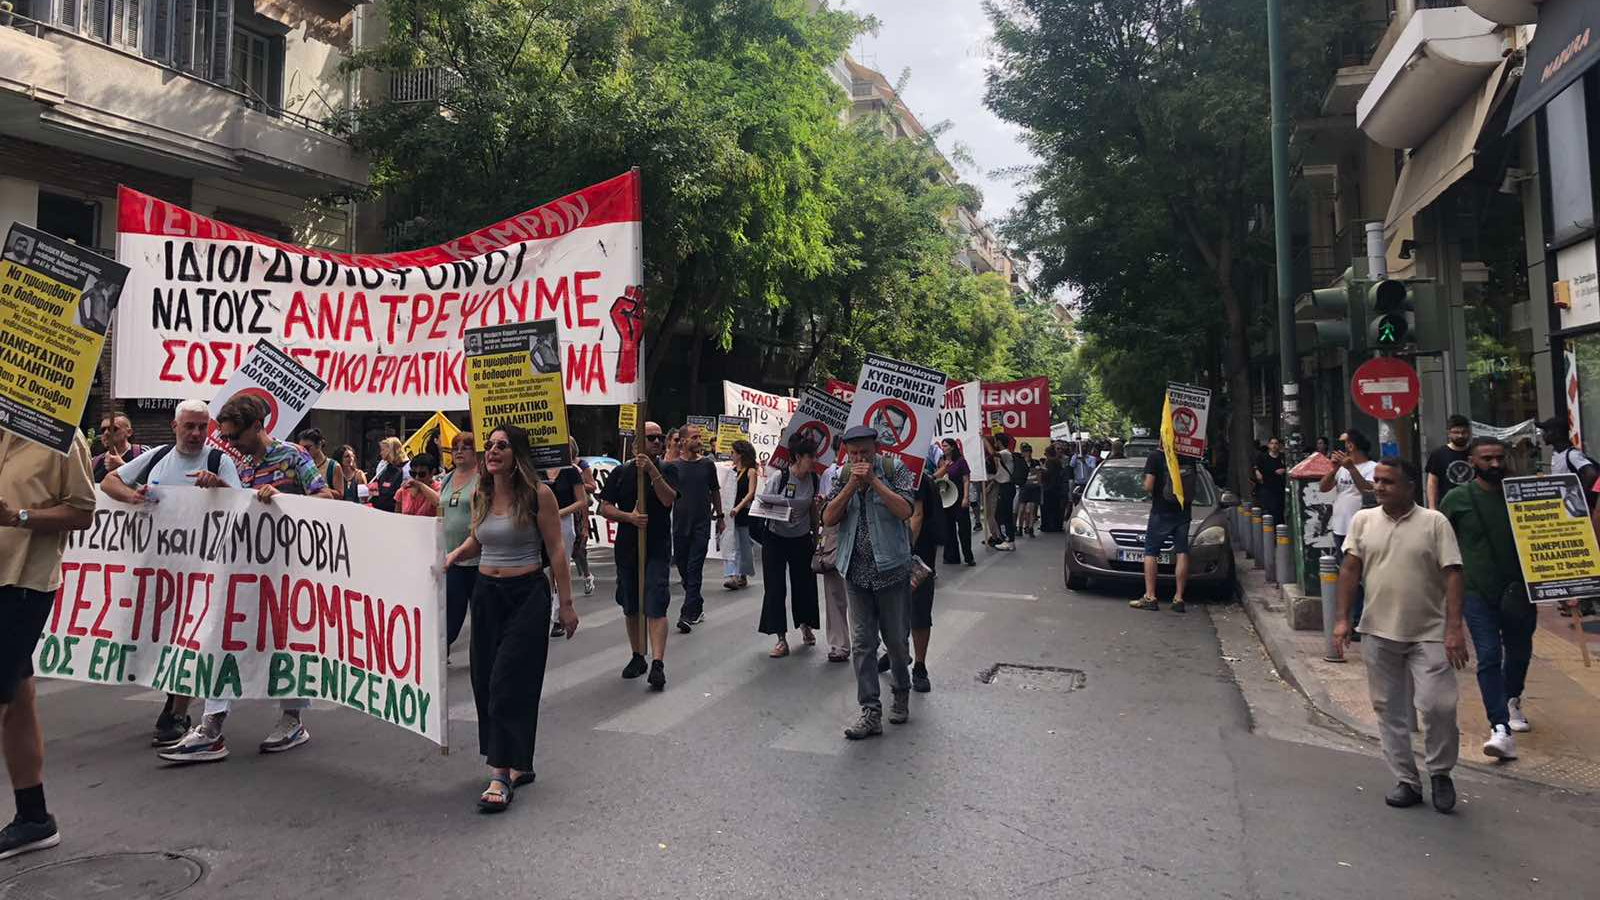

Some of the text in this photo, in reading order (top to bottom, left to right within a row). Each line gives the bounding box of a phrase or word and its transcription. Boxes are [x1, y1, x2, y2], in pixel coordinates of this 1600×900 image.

[440, 195, 591, 260] ΚΑΜΡΑΝ
[164, 240, 254, 283] ΙΔΙΟΙ
[152, 287, 193, 333] ΝΑ
[196, 288, 273, 334] ΤΟΥΣ
[1, 329, 75, 373] ΠΑΝΕΡΓΑΤΙΚΟ
[15, 374, 28, 389] 12
[240, 363, 306, 413] ΔΟΛΟΦΟΝΩΝ
[250, 354, 311, 401] ΚΥΒΕΡΝΗΣΗ
[867, 369, 936, 396] ΚΥΒΕΡΝΗΣΗ
[137, 399, 177, 410] ΨΗΣΤΑΡΙ
[485, 399, 549, 416] ΠΑΝΕΡΓΑΤΙΚΟ
[741, 389, 780, 411] ΠΥΛΟΣ
[861, 380, 936, 409] ΔΟΛΟΦΟΝΩΝ
[799, 405, 846, 431] ΔΟΛΟΦΟΝΩΝ
[804, 397, 849, 423] ΚΥΒΕΡΝΗΣΗ
[157, 528, 196, 557] και
[221, 573, 421, 687] ΕΝΩΜΕΝΟΙ
[88, 637, 137, 683] ΕΡΓ.
[151, 643, 243, 698] ΕΛΕΝΑ
[267, 651, 431, 734] ΒΕΝΙΖΕΛΟΥ
